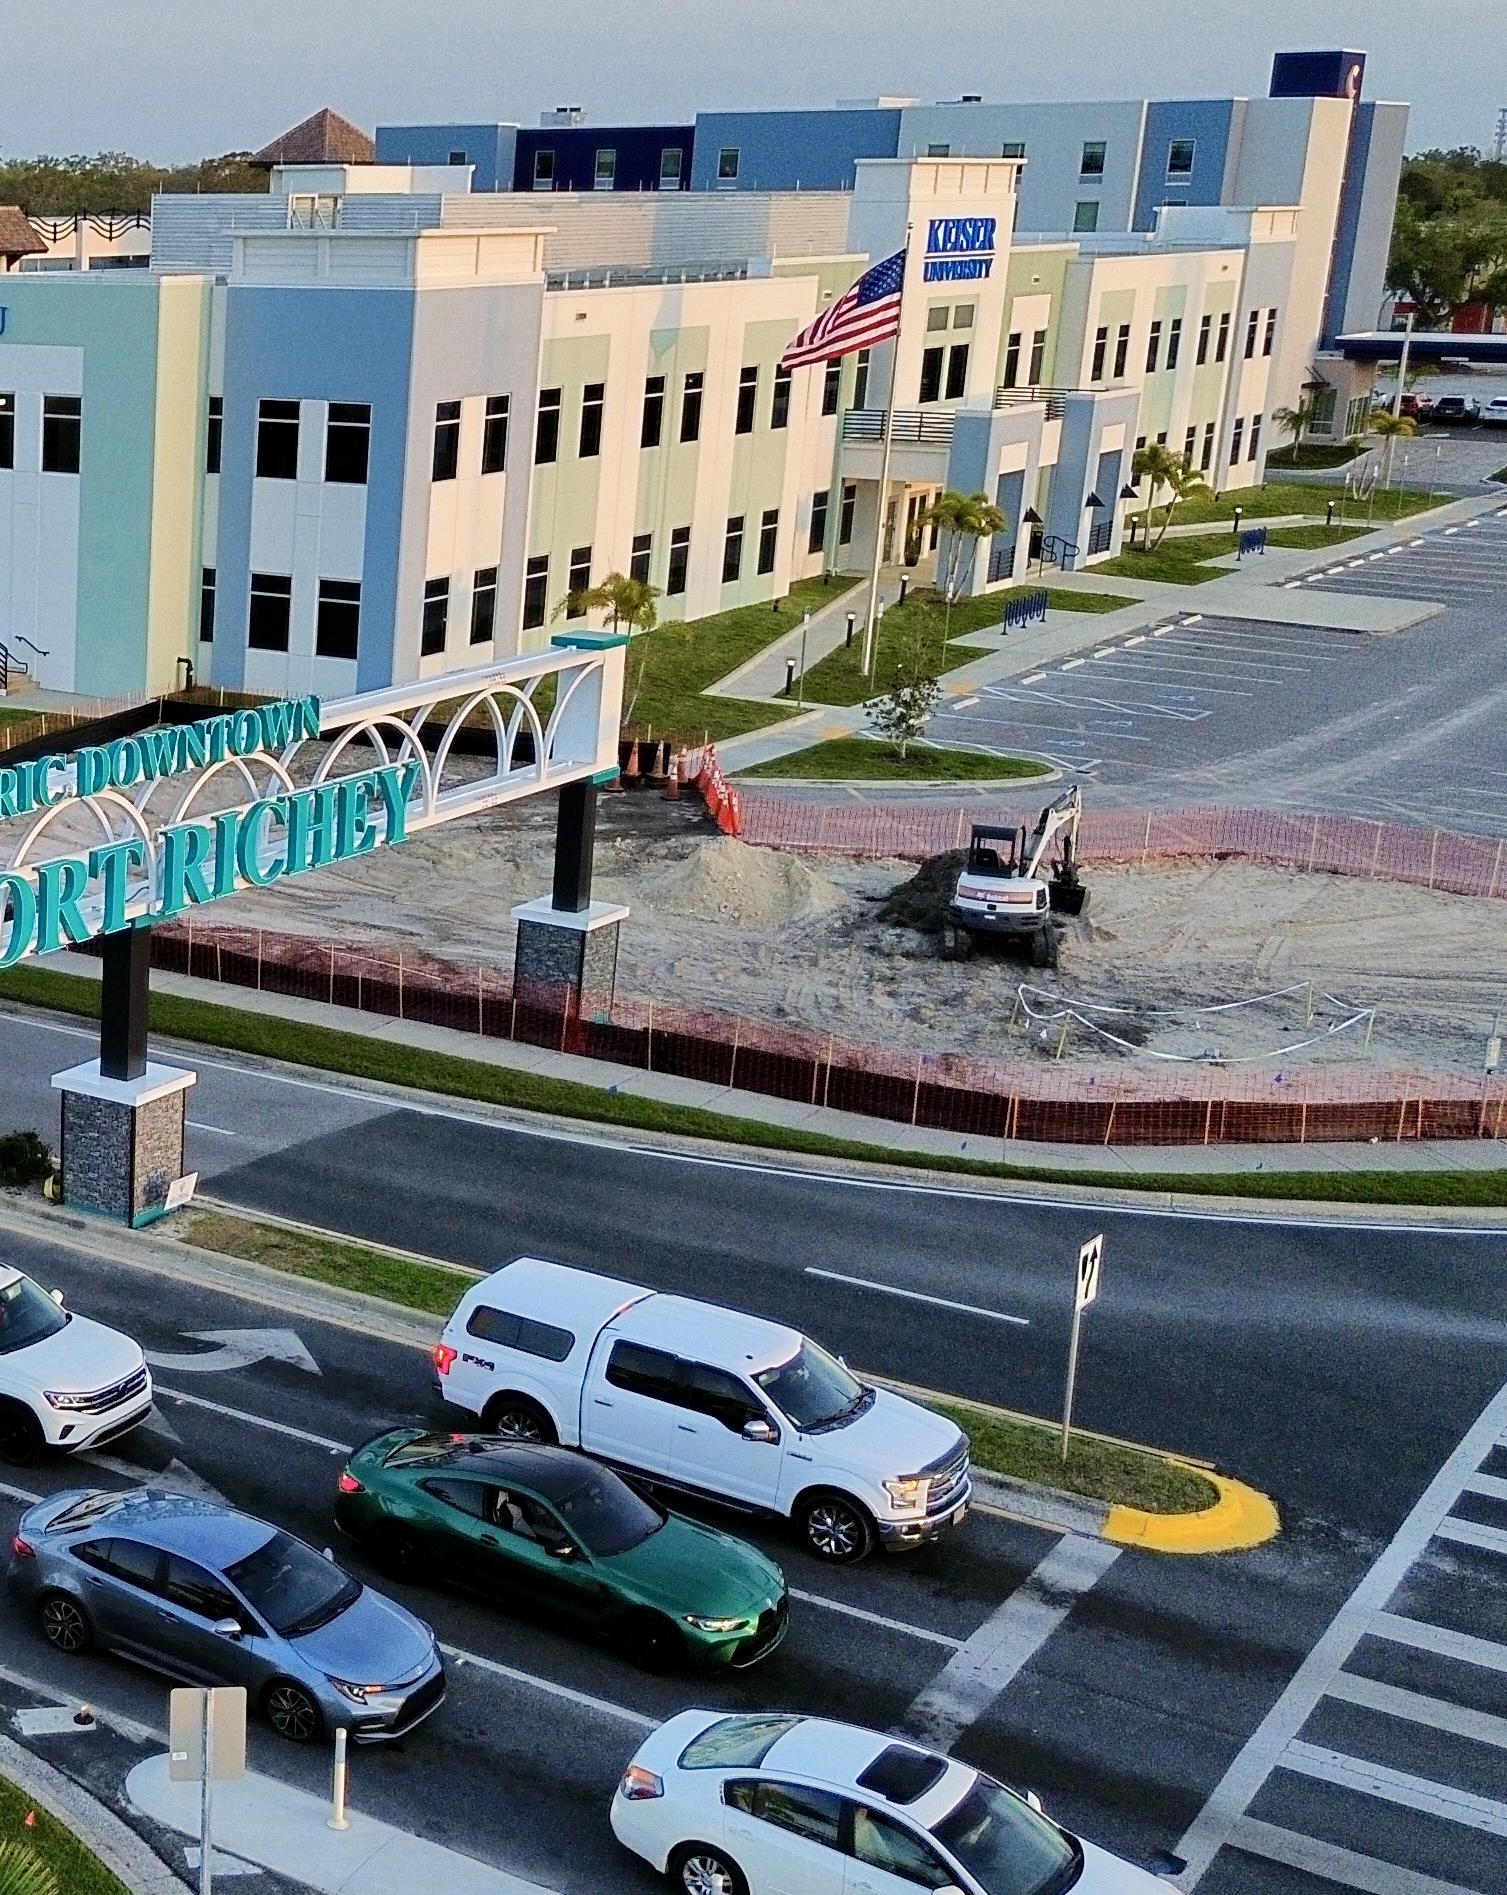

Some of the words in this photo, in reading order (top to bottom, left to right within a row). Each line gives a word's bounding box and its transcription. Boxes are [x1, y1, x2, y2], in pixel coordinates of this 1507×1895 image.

[923, 257, 993, 283] UNIVERSITY
[926, 217, 996, 254] KEISER
[75, 695, 321, 799] DOWNTOWN
[159, 761, 422, 916] RICHEY
